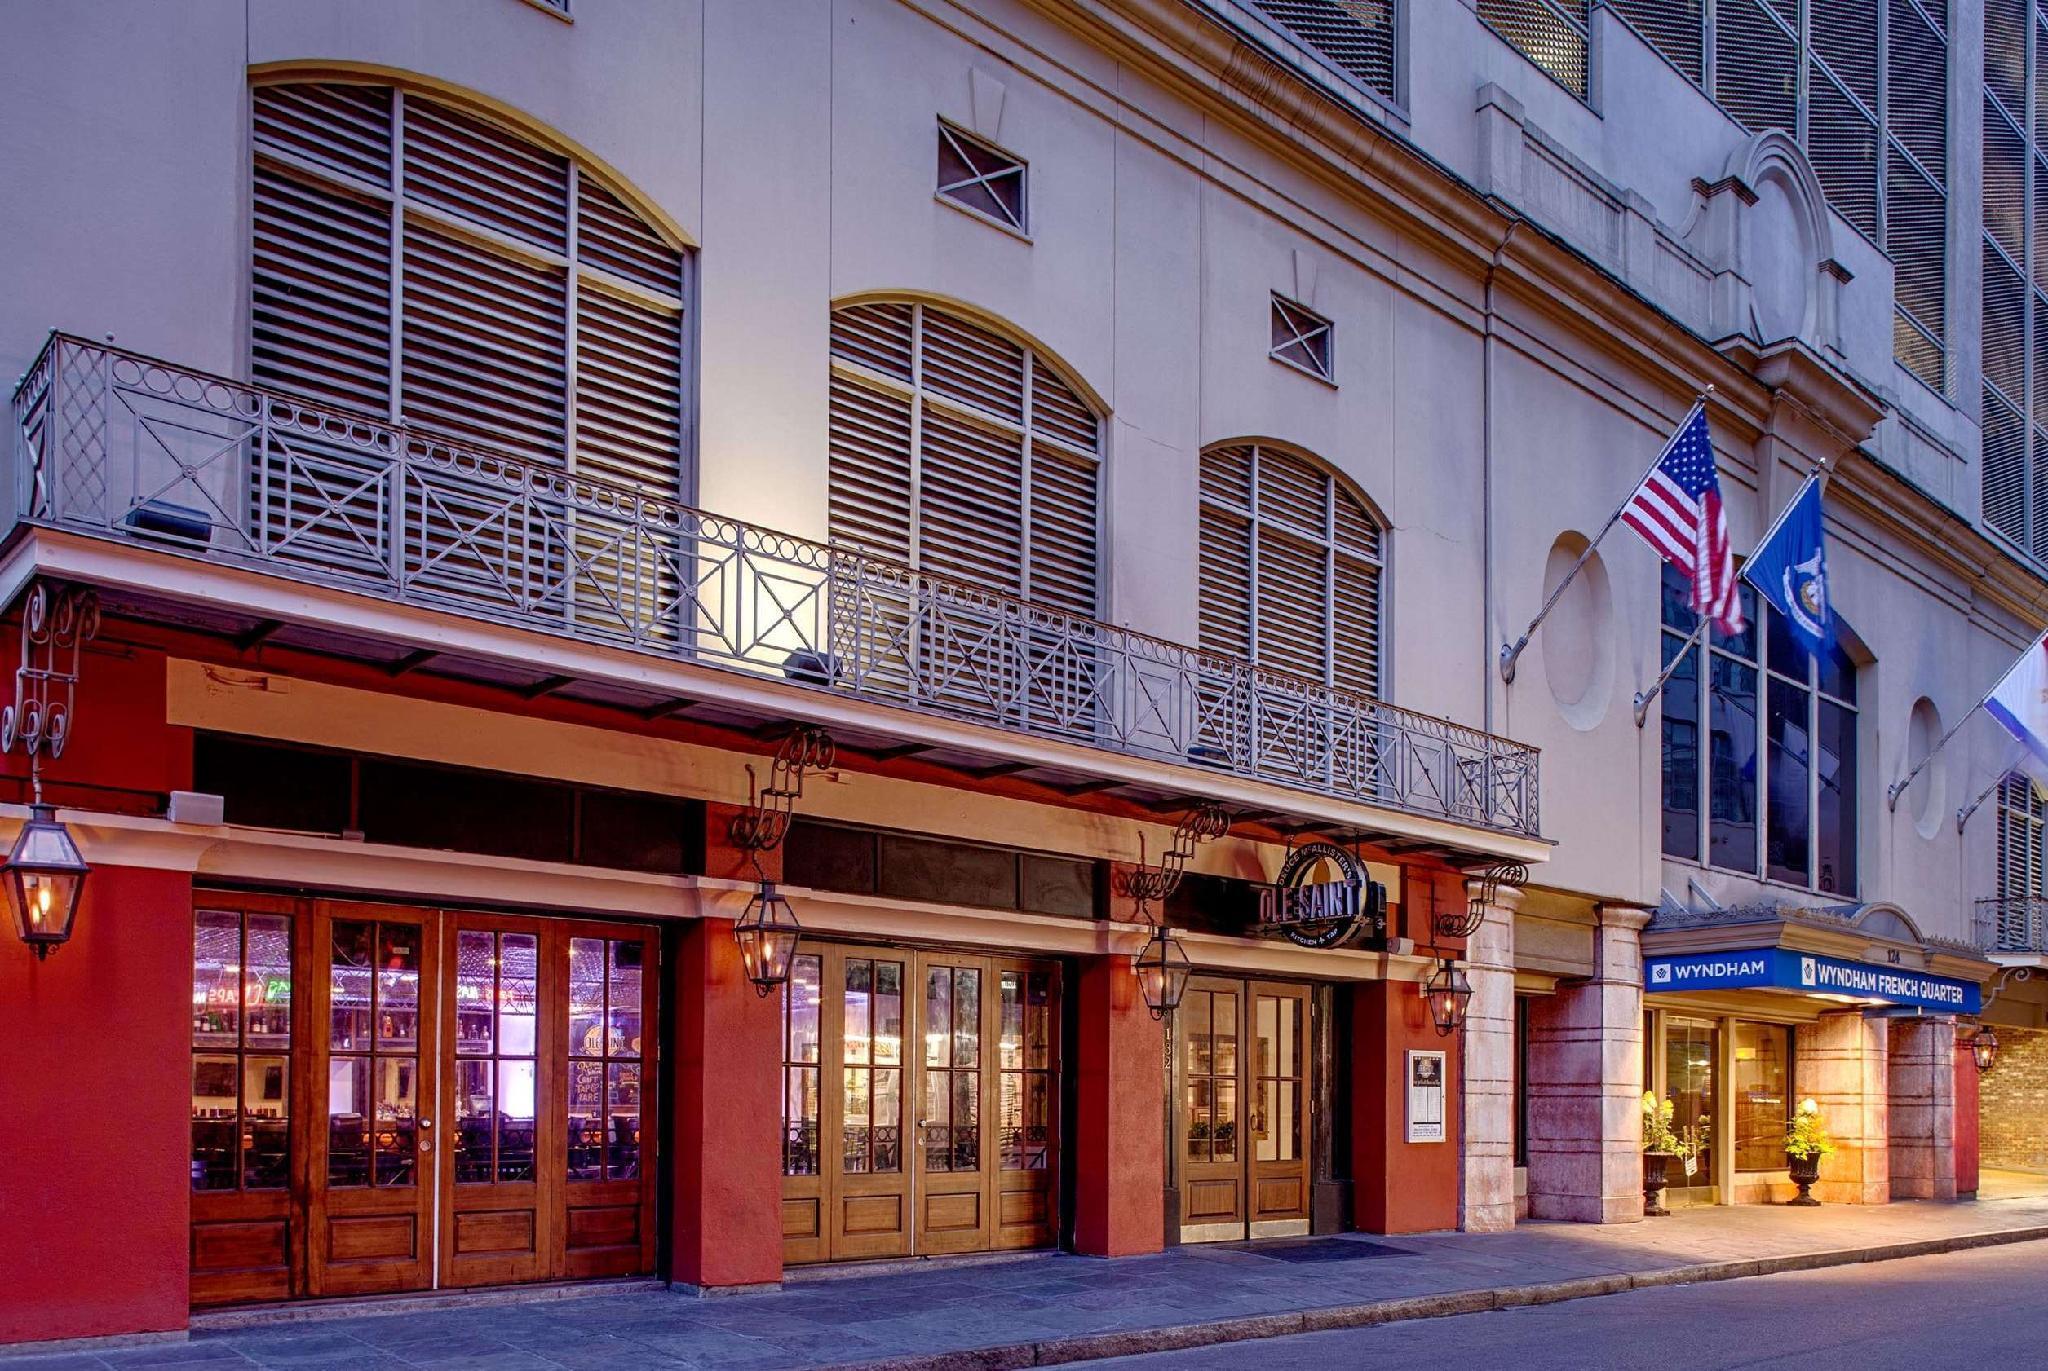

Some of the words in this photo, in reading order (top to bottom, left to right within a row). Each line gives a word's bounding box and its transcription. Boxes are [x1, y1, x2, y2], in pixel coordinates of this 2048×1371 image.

[1279, 853, 1300, 886] DEUCE
[1259, 887, 1293, 922] OLE
[1299, 879, 1360, 919] SAINT
[1675, 960, 1764, 979] WYNDHAM
[1887, 949, 1901, 964] 124
[1817, 963, 1876, 991] WYNDHAM
[1878, 975, 1918, 997] FRENCH
[1920, 981, 1963, 1004] QUARTER
